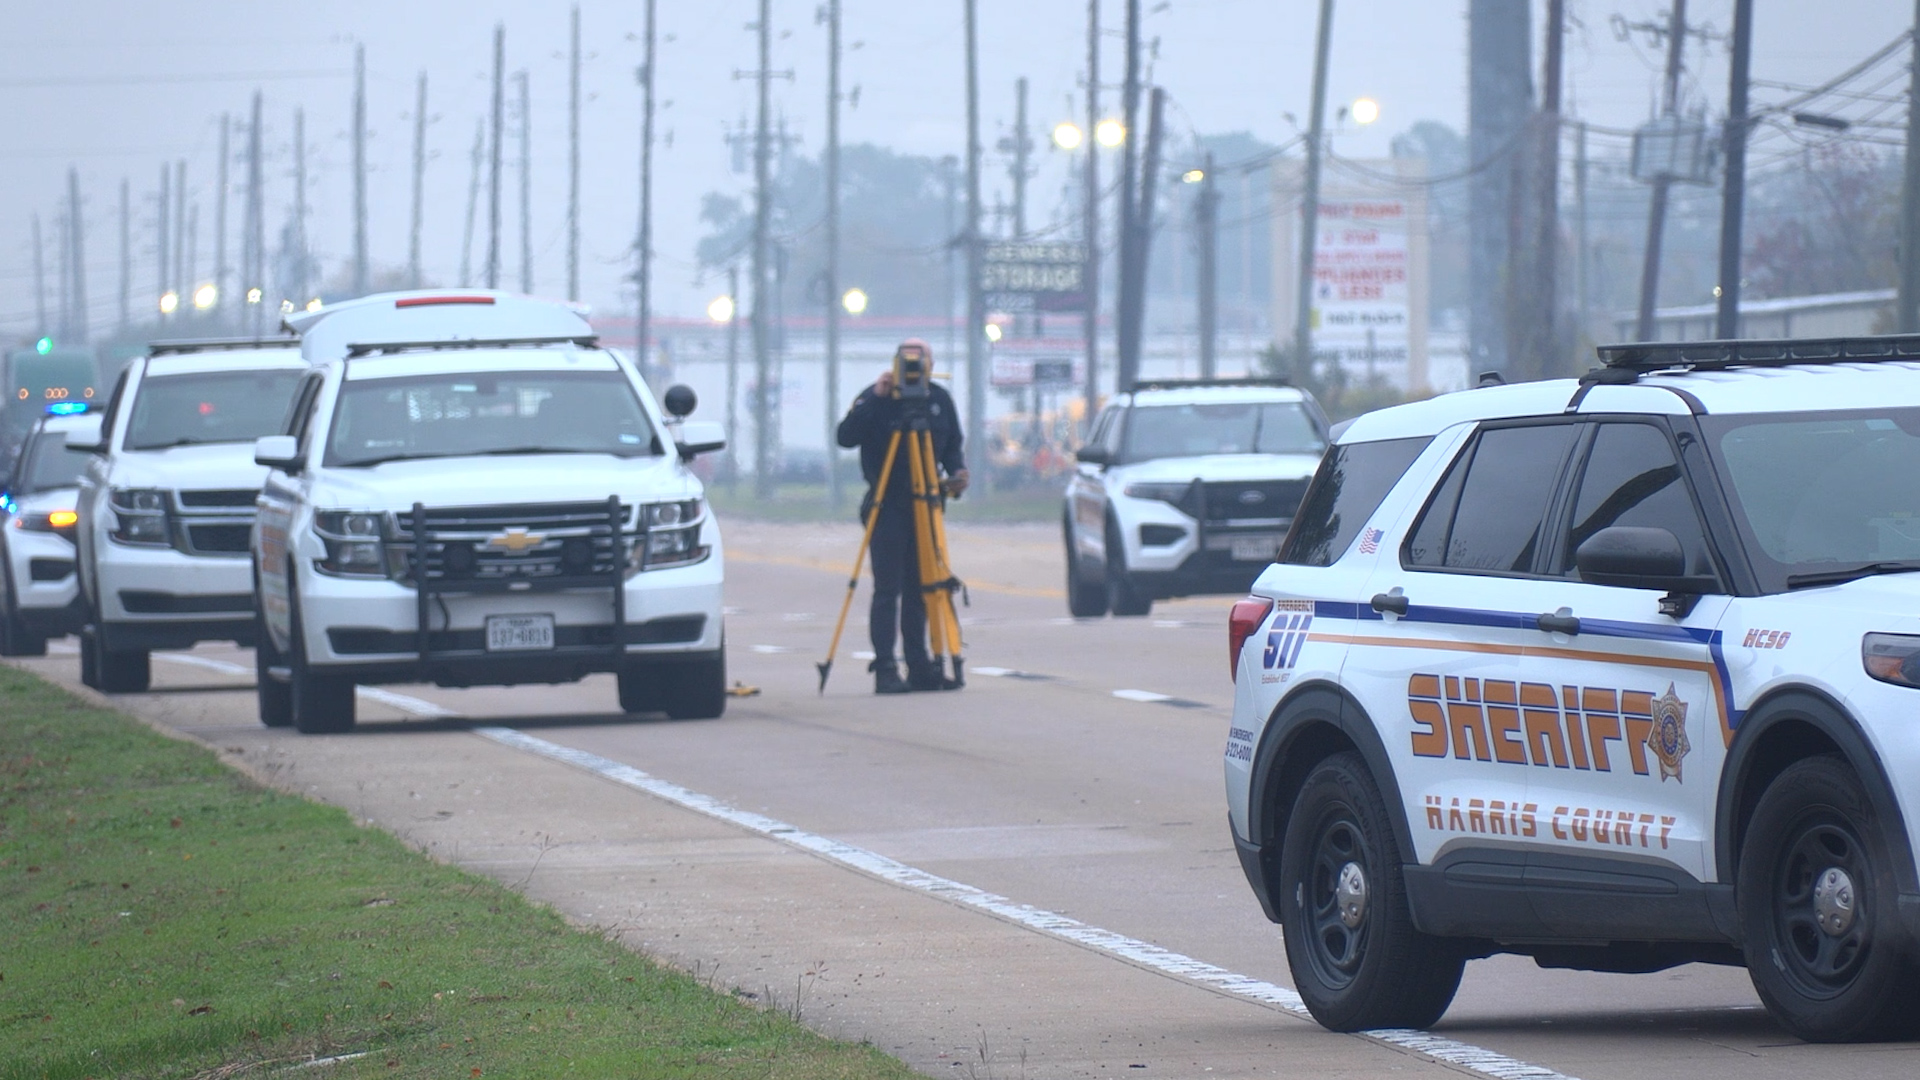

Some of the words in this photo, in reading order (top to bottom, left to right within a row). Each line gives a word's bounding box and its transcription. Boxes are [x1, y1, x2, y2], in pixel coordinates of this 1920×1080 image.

[981, 264, 1083, 291] STORAGE
[1277, 600, 1314, 612] EMERGENCY
[1263, 614, 1314, 669] 911
[1742, 628, 1791, 649] HCSO
[1408, 673, 1656, 776] SHERIFF
[1425, 795, 1538, 837] HARRIS
[1552, 806, 1677, 850] COUNTY
